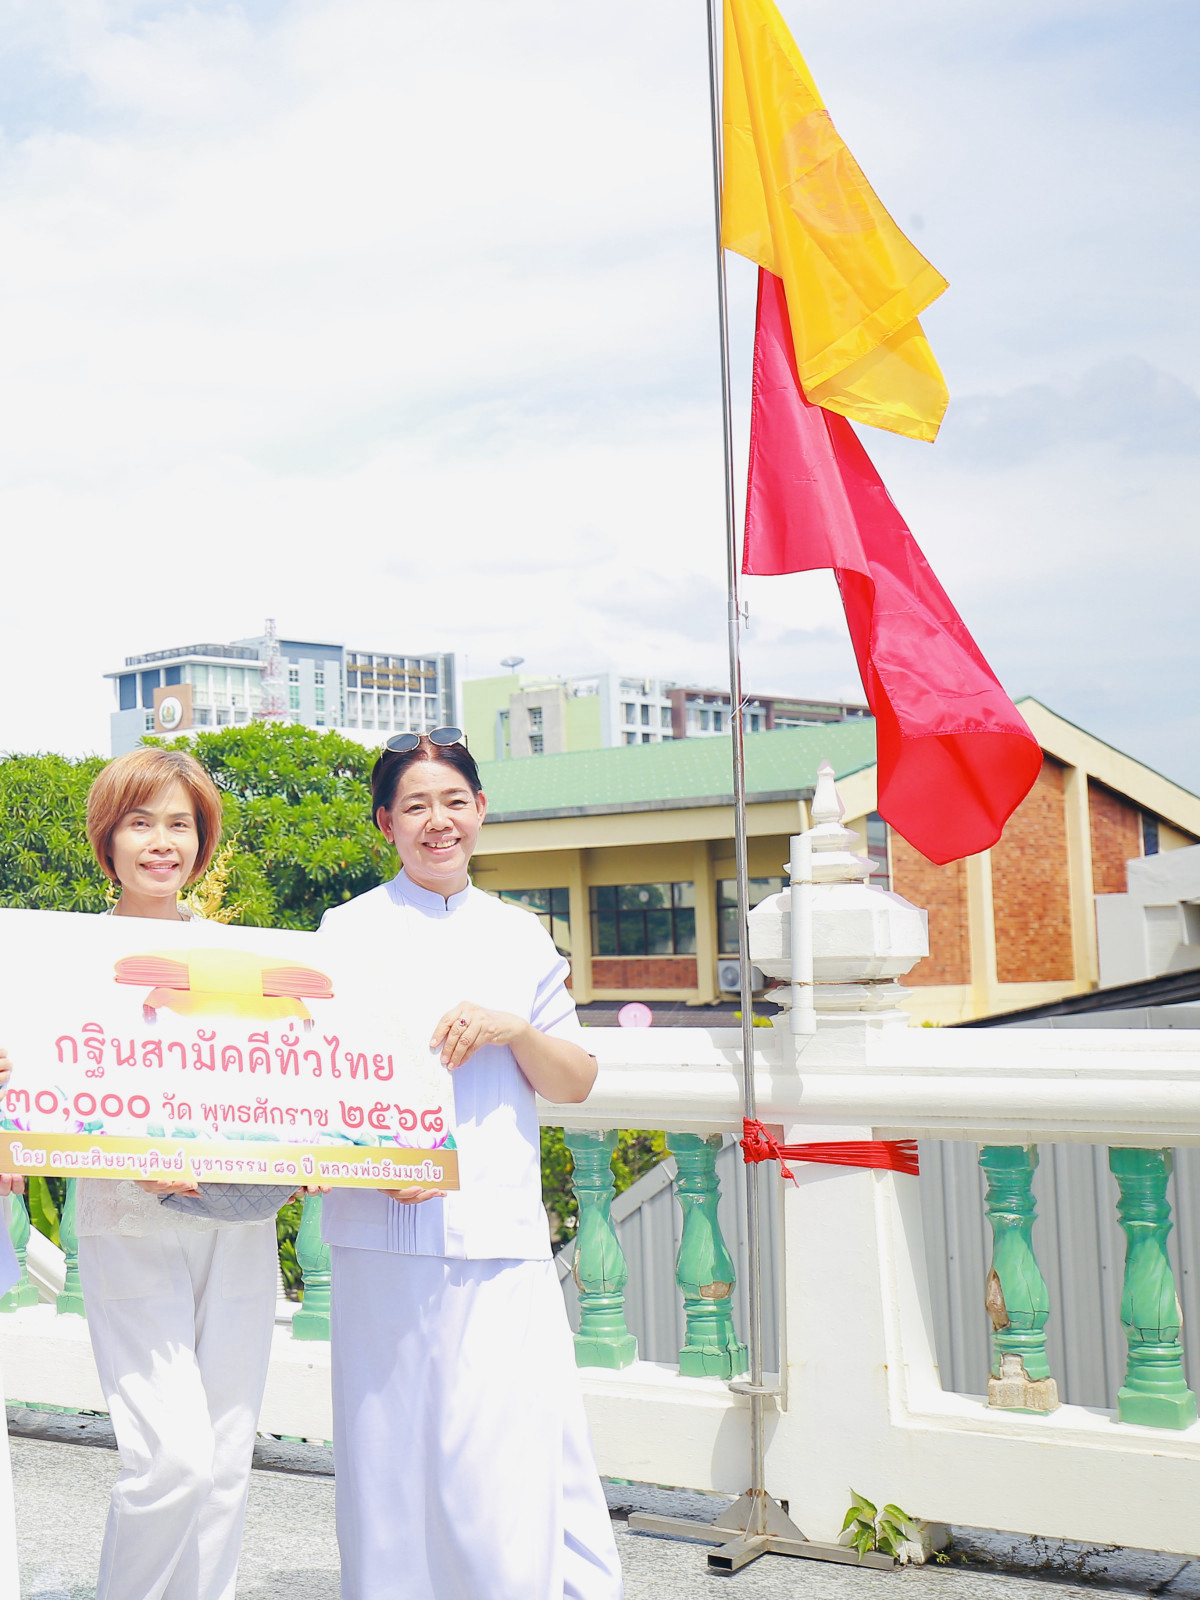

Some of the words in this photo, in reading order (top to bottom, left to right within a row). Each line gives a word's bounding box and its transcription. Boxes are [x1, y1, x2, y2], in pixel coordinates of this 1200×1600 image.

[55, 1022, 394, 1081] กฐินสามัคคีทั่วไทย
[6, 1088, 151, 1122] ๓๐,๐๐๐
[162, 1092, 192, 1120] วัด
[200, 1097, 329, 1132] พุทธศักราช
[339, 1101, 443, 1132] ๒๕๖๘
[12, 1145, 45, 1164] โดย
[52, 1149, 183, 1173] คณะศิษยานุศิษย์
[191, 1158, 267, 1176] บูชาธรรม
[274, 1163, 297, 1175] ๘๑
[303, 1157, 314, 1175] ปี
[321, 1160, 443, 1180] หลวงพ่อธัมมชโย
